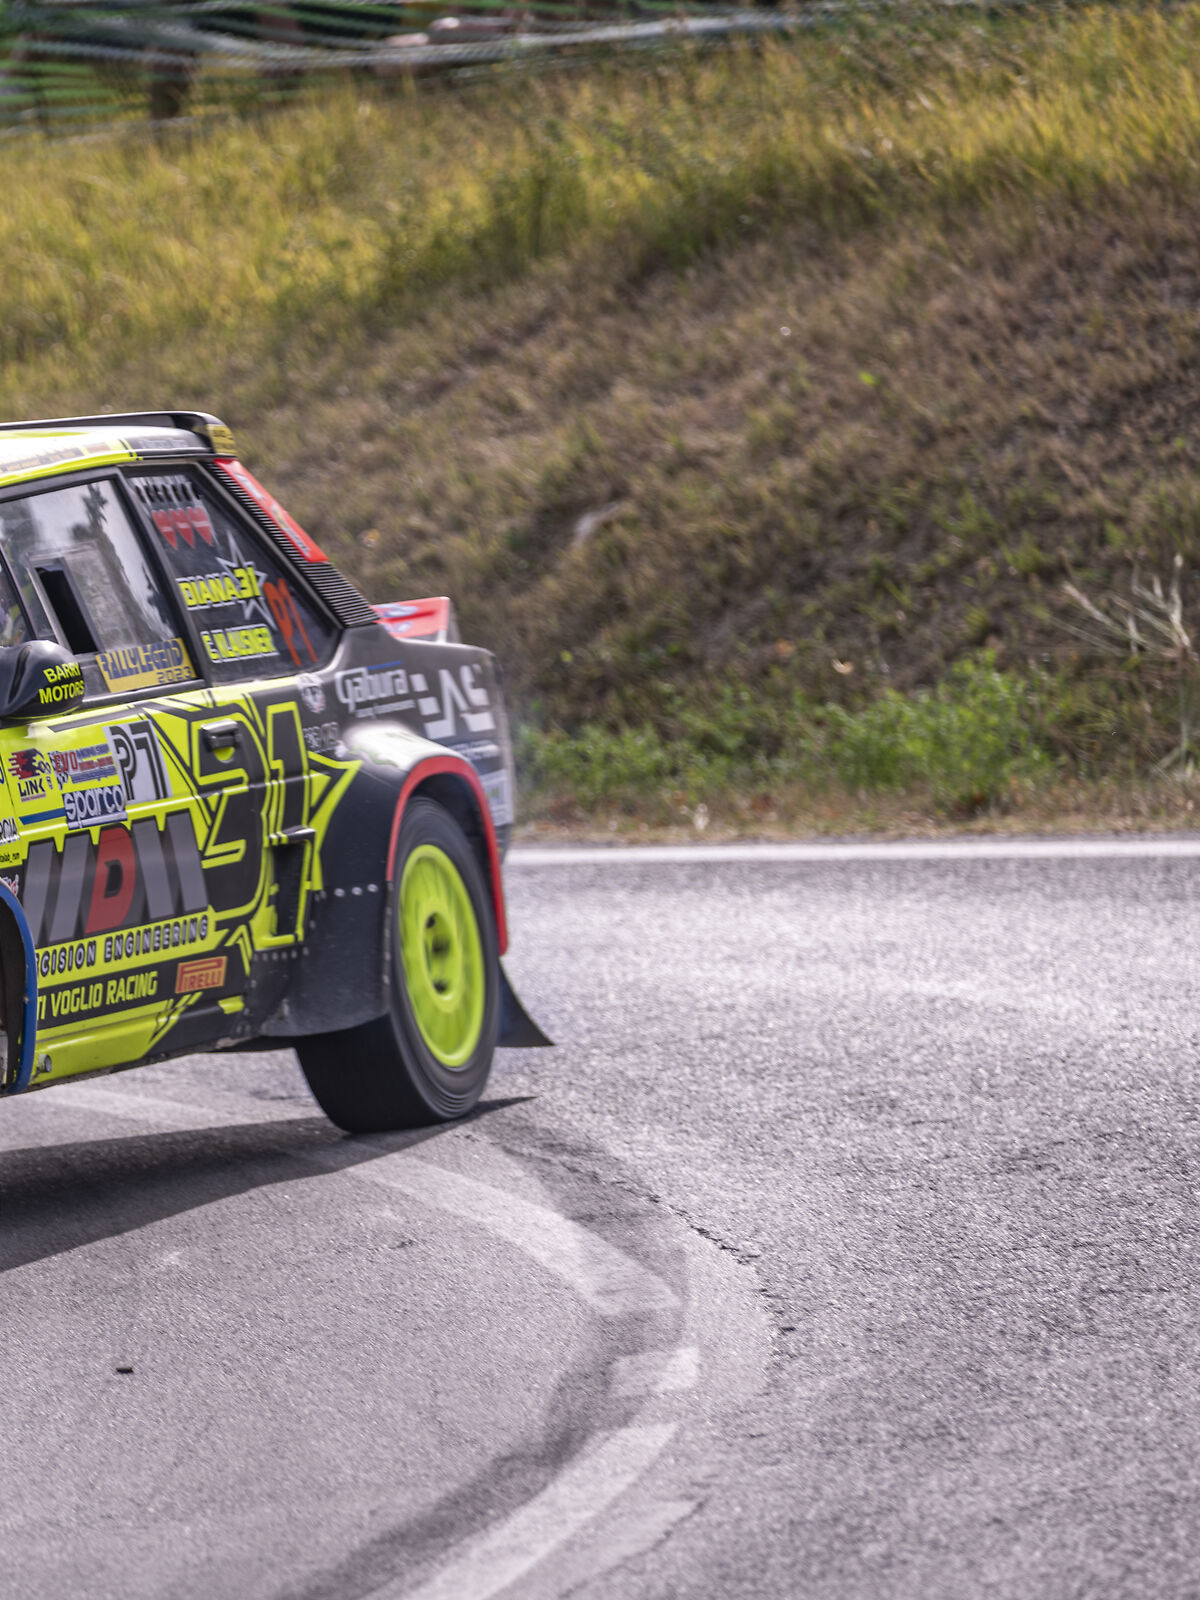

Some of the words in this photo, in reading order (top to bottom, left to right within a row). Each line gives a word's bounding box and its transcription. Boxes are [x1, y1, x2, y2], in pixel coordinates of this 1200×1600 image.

[43, 662, 81, 684] BARRY
[38, 680, 85, 705] MOTORS
[53, 751, 79, 774] EVO
[64, 784, 126, 829] sparco
[104, 914, 208, 963] ENGINEERING
[50, 982, 103, 1018] VOGLIO
[106, 970, 158, 1005] RACING
[176, 956, 227, 994] PIRELLI
